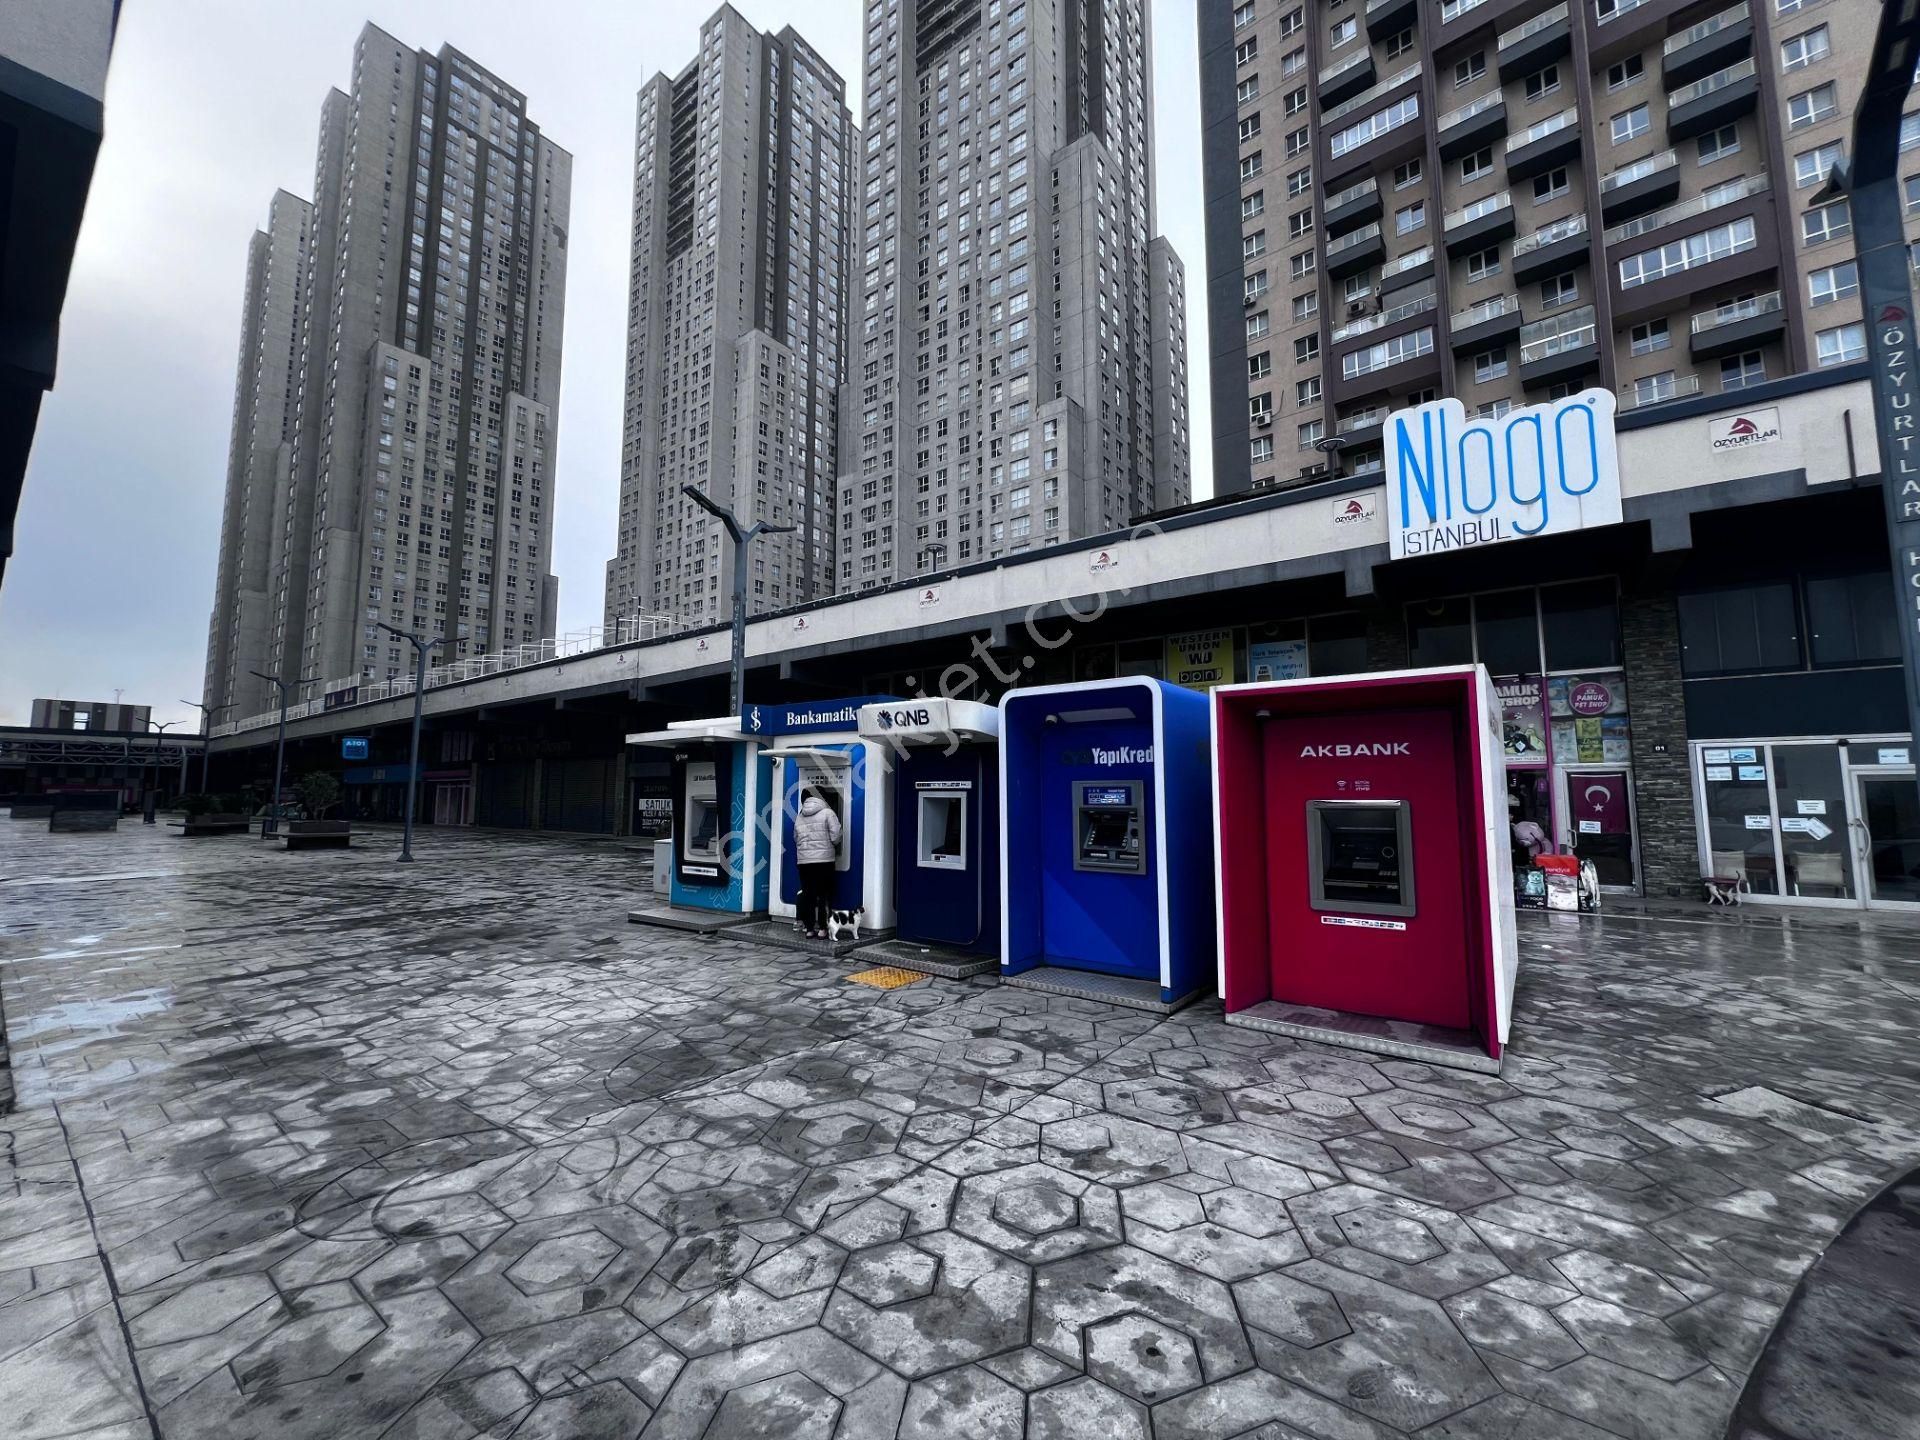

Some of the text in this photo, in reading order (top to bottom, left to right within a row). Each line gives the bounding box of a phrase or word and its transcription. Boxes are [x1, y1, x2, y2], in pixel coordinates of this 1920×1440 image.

[1396, 404, 1599, 535] Nlogo
[1402, 516, 1511, 556] İSTANBUL
[1169, 631, 1231, 646] WESTERN
[1178, 640, 1221, 652] UNION
[786, 706, 858, 726] Bankamatik
[894, 709, 930, 727] QNB
[1300, 742, 1411, 758] AKBANK
